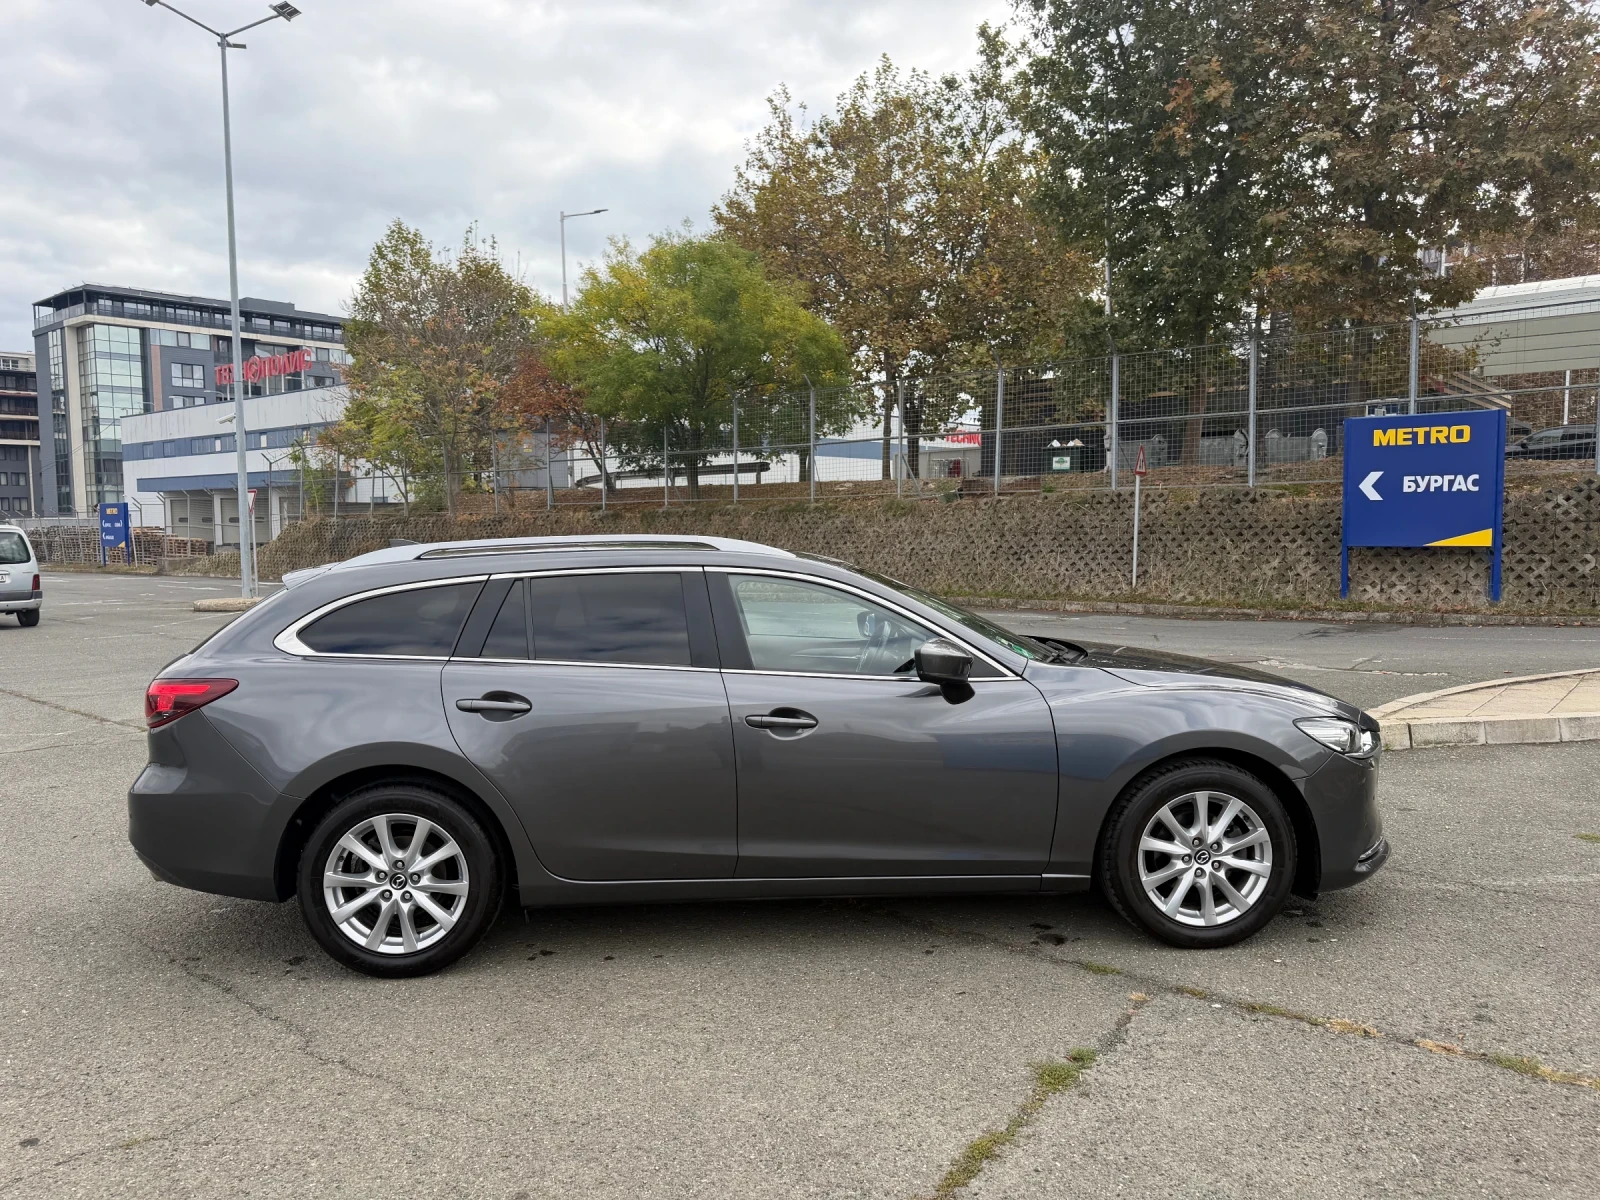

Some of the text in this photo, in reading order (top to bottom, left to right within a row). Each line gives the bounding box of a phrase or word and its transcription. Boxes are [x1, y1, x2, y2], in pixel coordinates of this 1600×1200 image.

[946, 430, 981, 446] TECHN
[1373, 425, 1471, 447] METRO
[1402, 474, 1480, 493] БУРГАС
